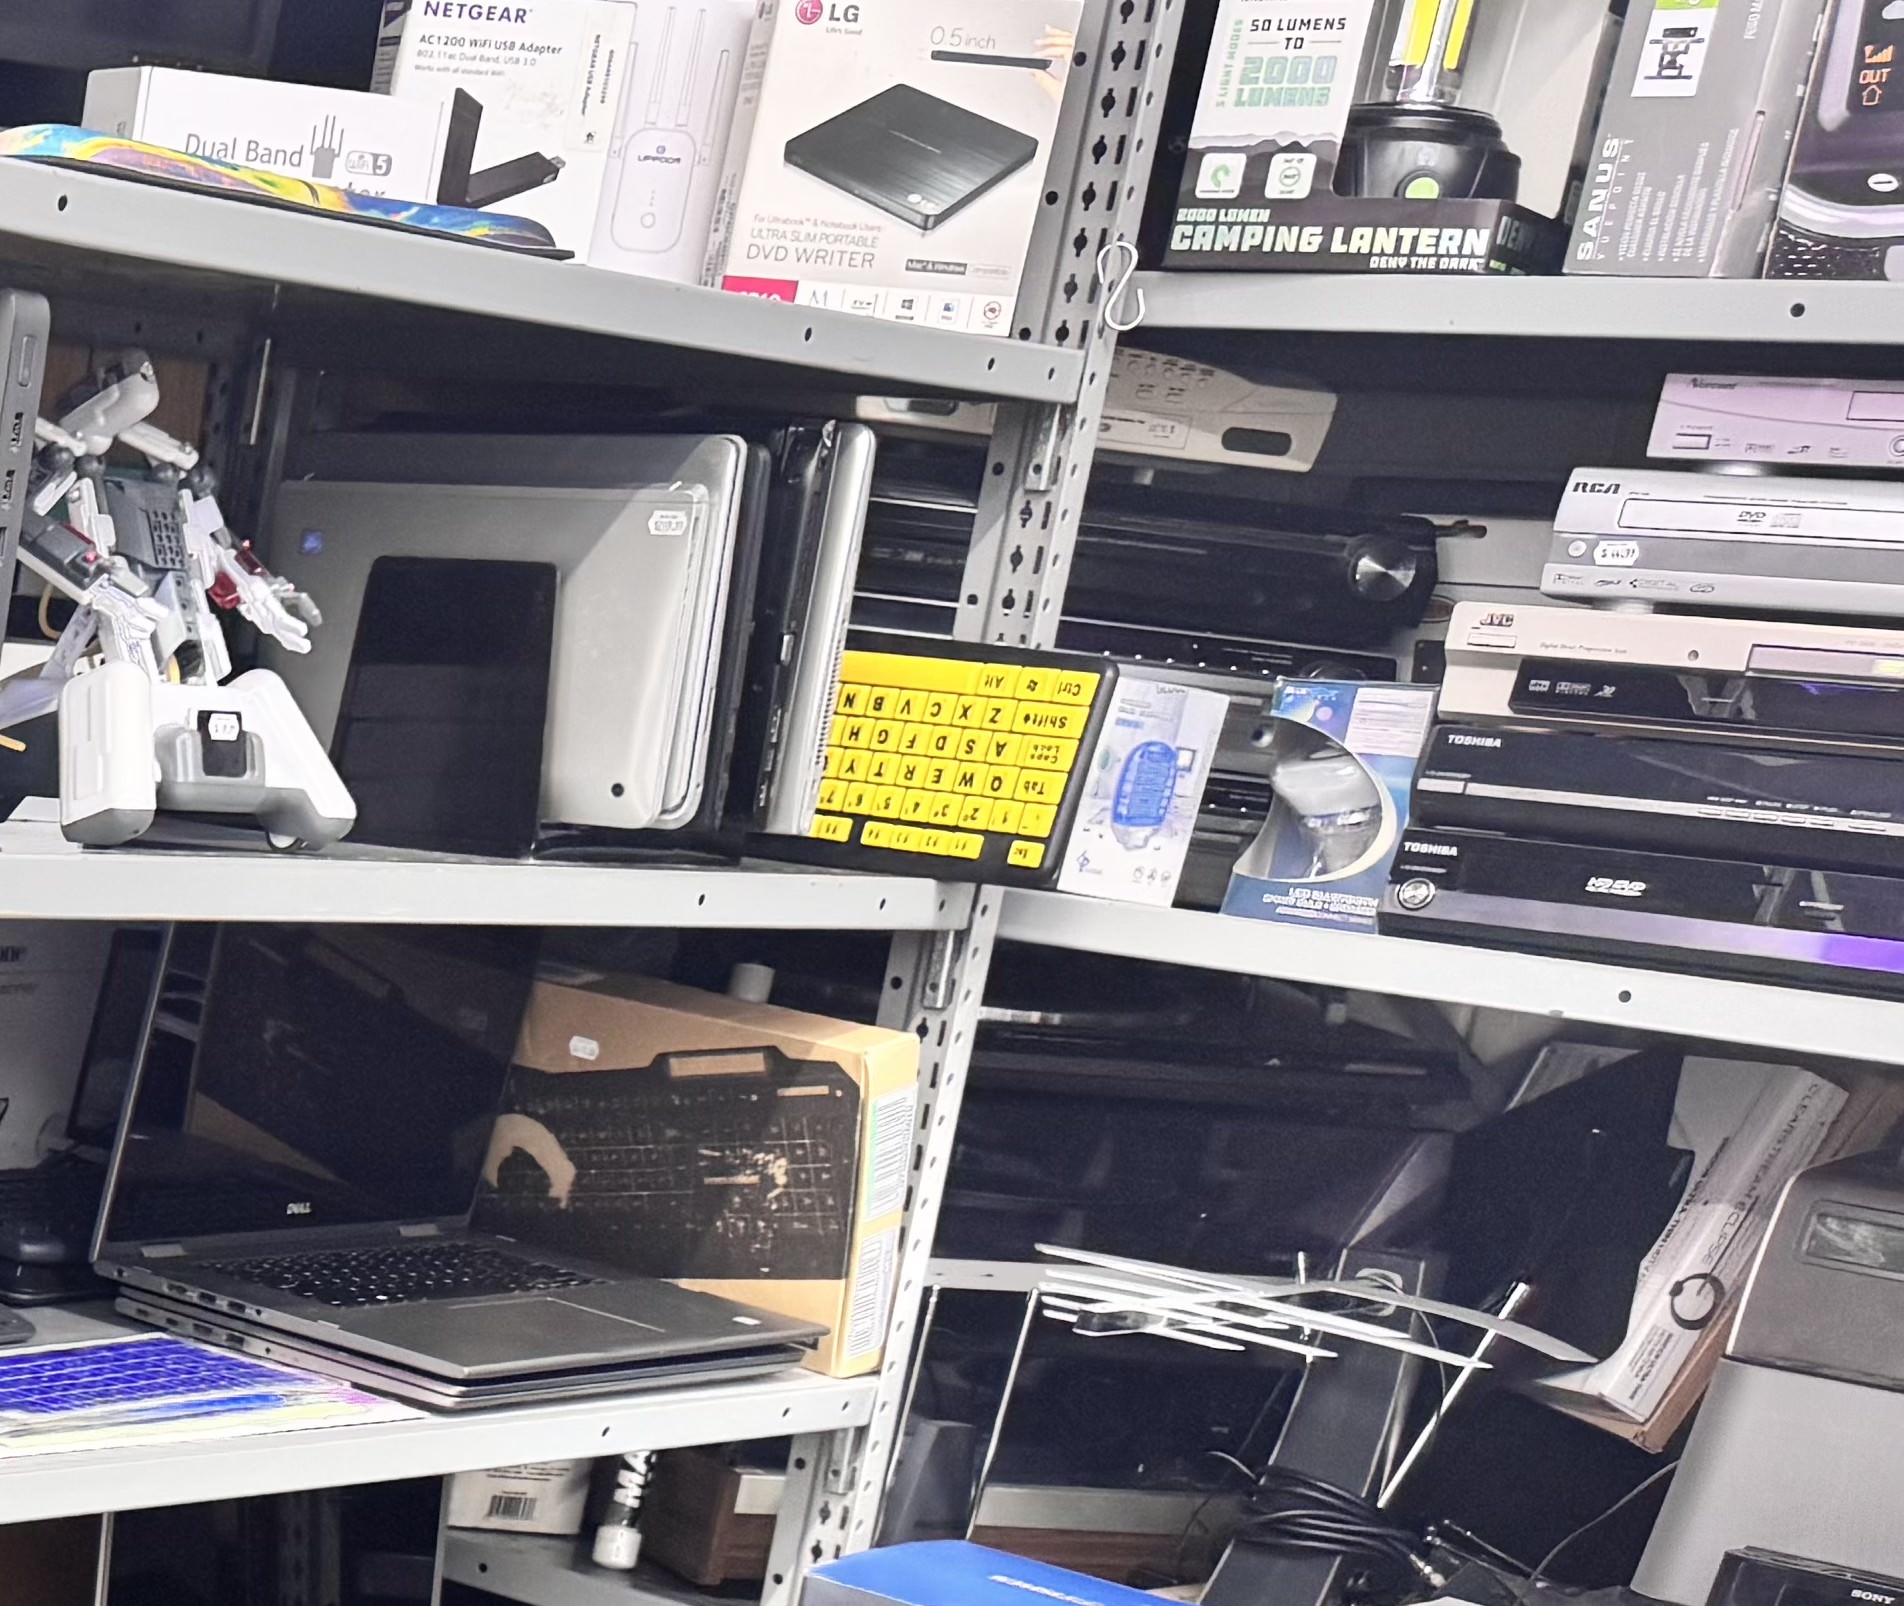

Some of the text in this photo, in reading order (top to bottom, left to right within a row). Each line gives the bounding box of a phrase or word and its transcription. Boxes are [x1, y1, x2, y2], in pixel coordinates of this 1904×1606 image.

[423, 1, 528, 24] NETGEAR
[829, 4, 860, 24] LG
[1277, 17, 1347, 32] LUMENS
[419, 34, 465, 47] AC1200
[494, 40, 516, 51] USB
[519, 41, 563, 55] Adapter
[930, 25, 962, 47] 0.5
[1284, 36, 1304, 50] TO
[245, 140, 304, 167] Band
[1577, 137, 1620, 261] SANUS
[1170, 225, 1324, 252] CAMPING
[1330, 226, 1491, 256] LANTERN
[747, 244, 876, 269] DVD WRITER
[1573, 481, 1620, 495] RCA
[1448, 734, 1502, 748] TOSHIBA
[1404, 842, 1458, 857] TOSHIBA
[1851, 1589, 1896, 1605] SONY
